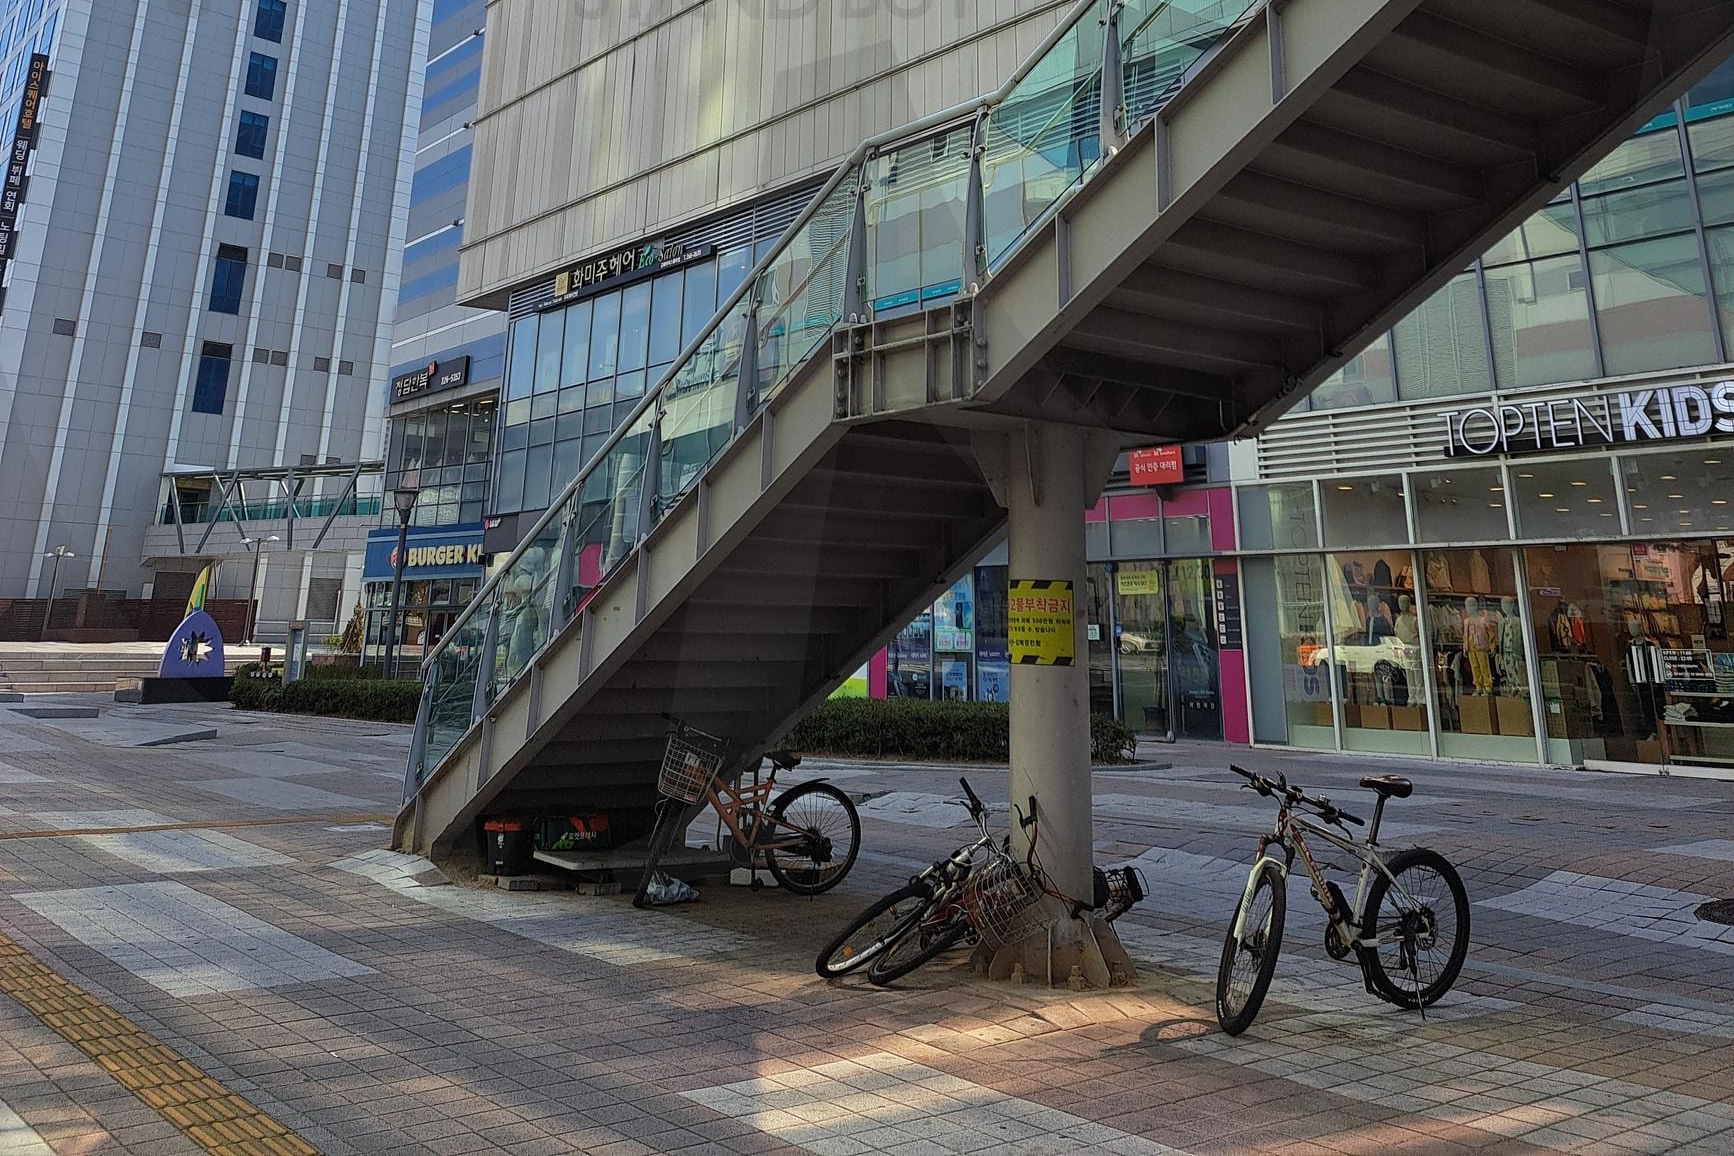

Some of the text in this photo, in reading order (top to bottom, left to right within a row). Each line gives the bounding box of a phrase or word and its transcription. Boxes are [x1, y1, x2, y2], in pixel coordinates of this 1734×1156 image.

[22, 61, 44, 129] 아이스퀘어호텔
[15, 140, 28, 161] 웨딩
[9, 165, 22, 185] 뷔페
[571, 248, 635, 289] 화미주헤어
[395, 371, 428, 397] 청담한복
[1437, 395, 1614, 457] TOPTEN
[407, 544, 465, 567] BURGER
[1008, 597, 1071, 613] 고물부착금지
